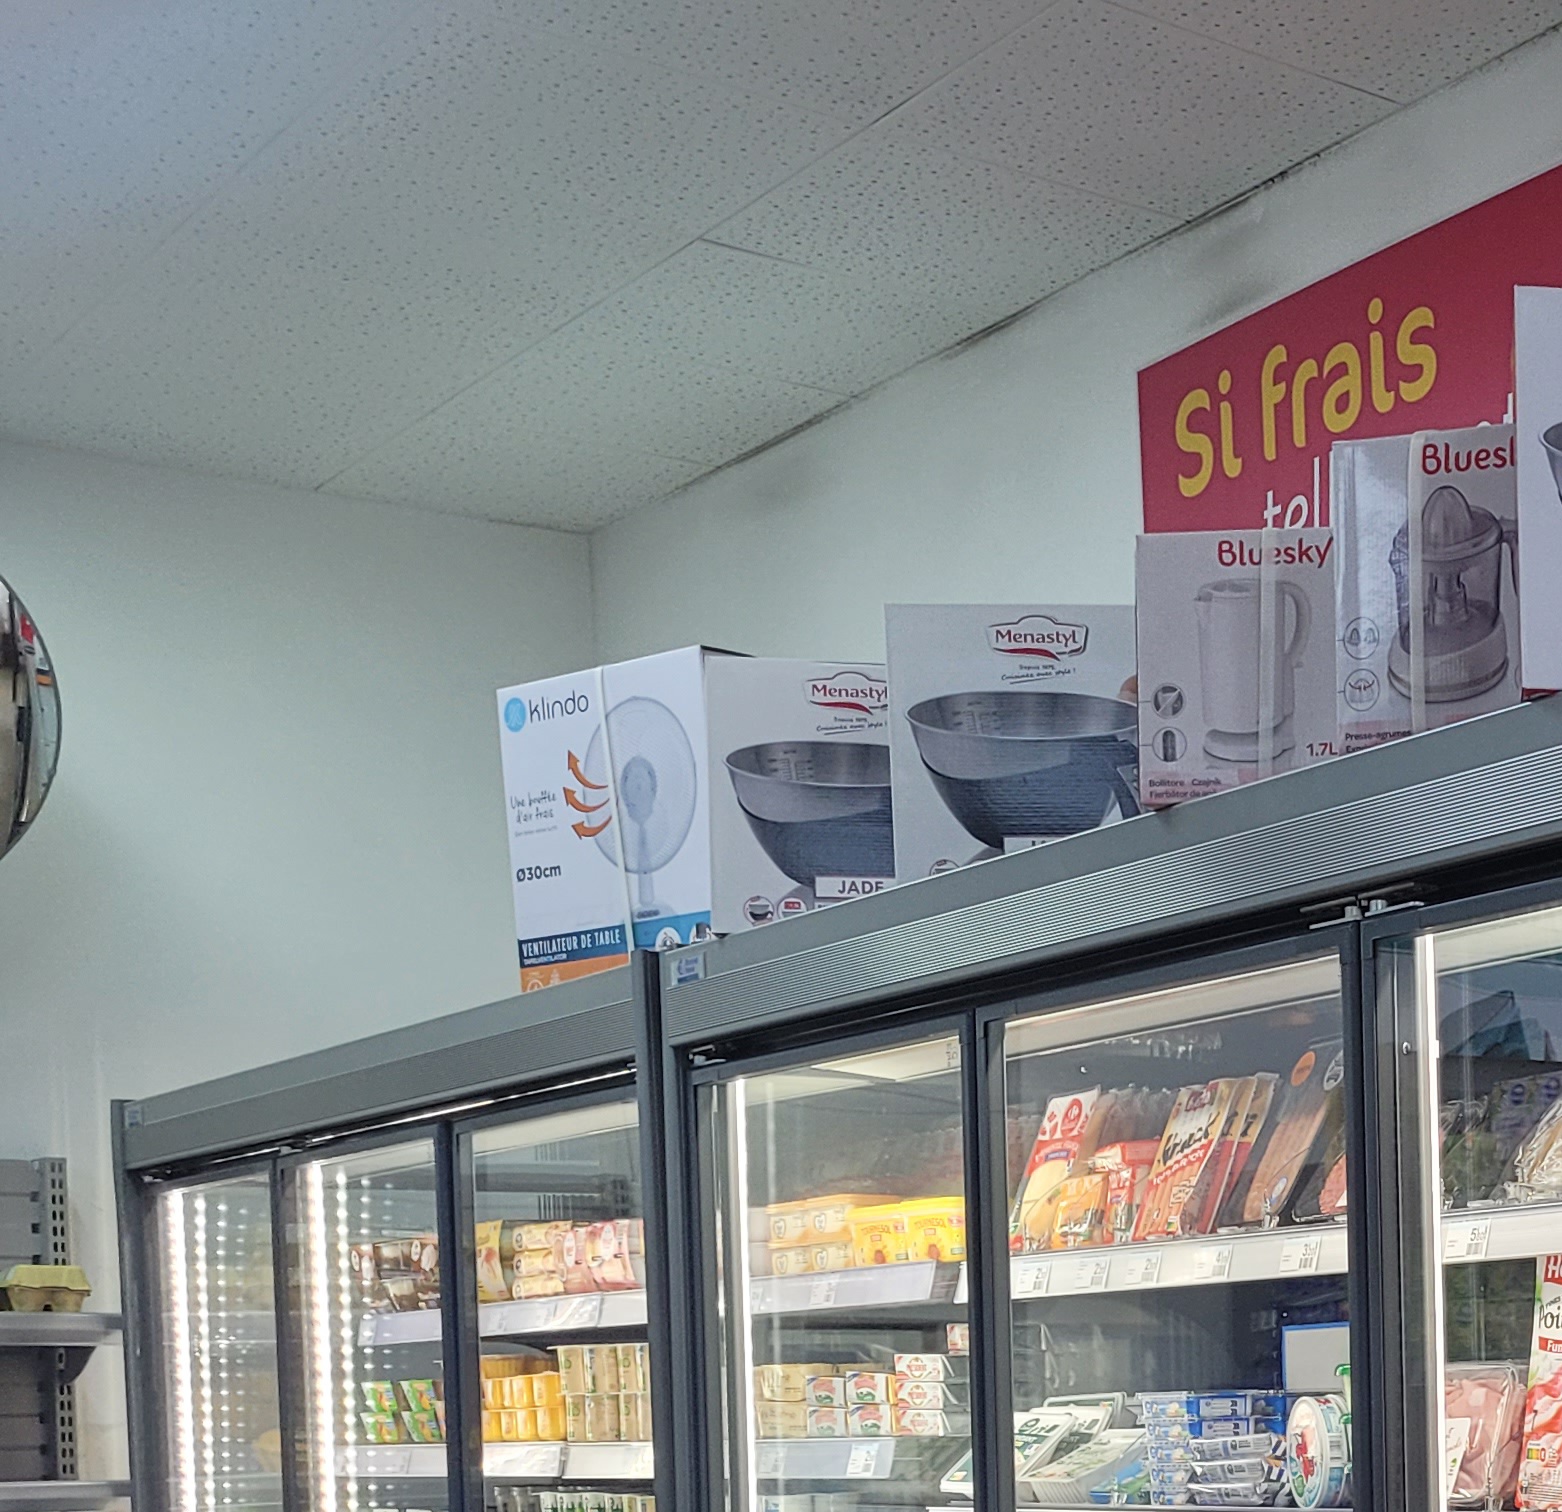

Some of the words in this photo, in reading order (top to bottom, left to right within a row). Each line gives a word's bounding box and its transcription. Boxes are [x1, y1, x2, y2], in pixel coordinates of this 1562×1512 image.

[1175, 369, 1243, 497] Si
[1262, 297, 1438, 462] frais
[995, 629, 1080, 647] Menastyl
[810, 683, 887, 703] Menastyl
[529, 690, 589, 724] klindo
[1305, 742, 1338, 757] 1.7L
[515, 864, 562, 883] Ø30cm
[837, 879, 884, 895] JADE
[521, 934, 578, 957] VENTILATEUR
[594, 928, 621, 946] TABLE
